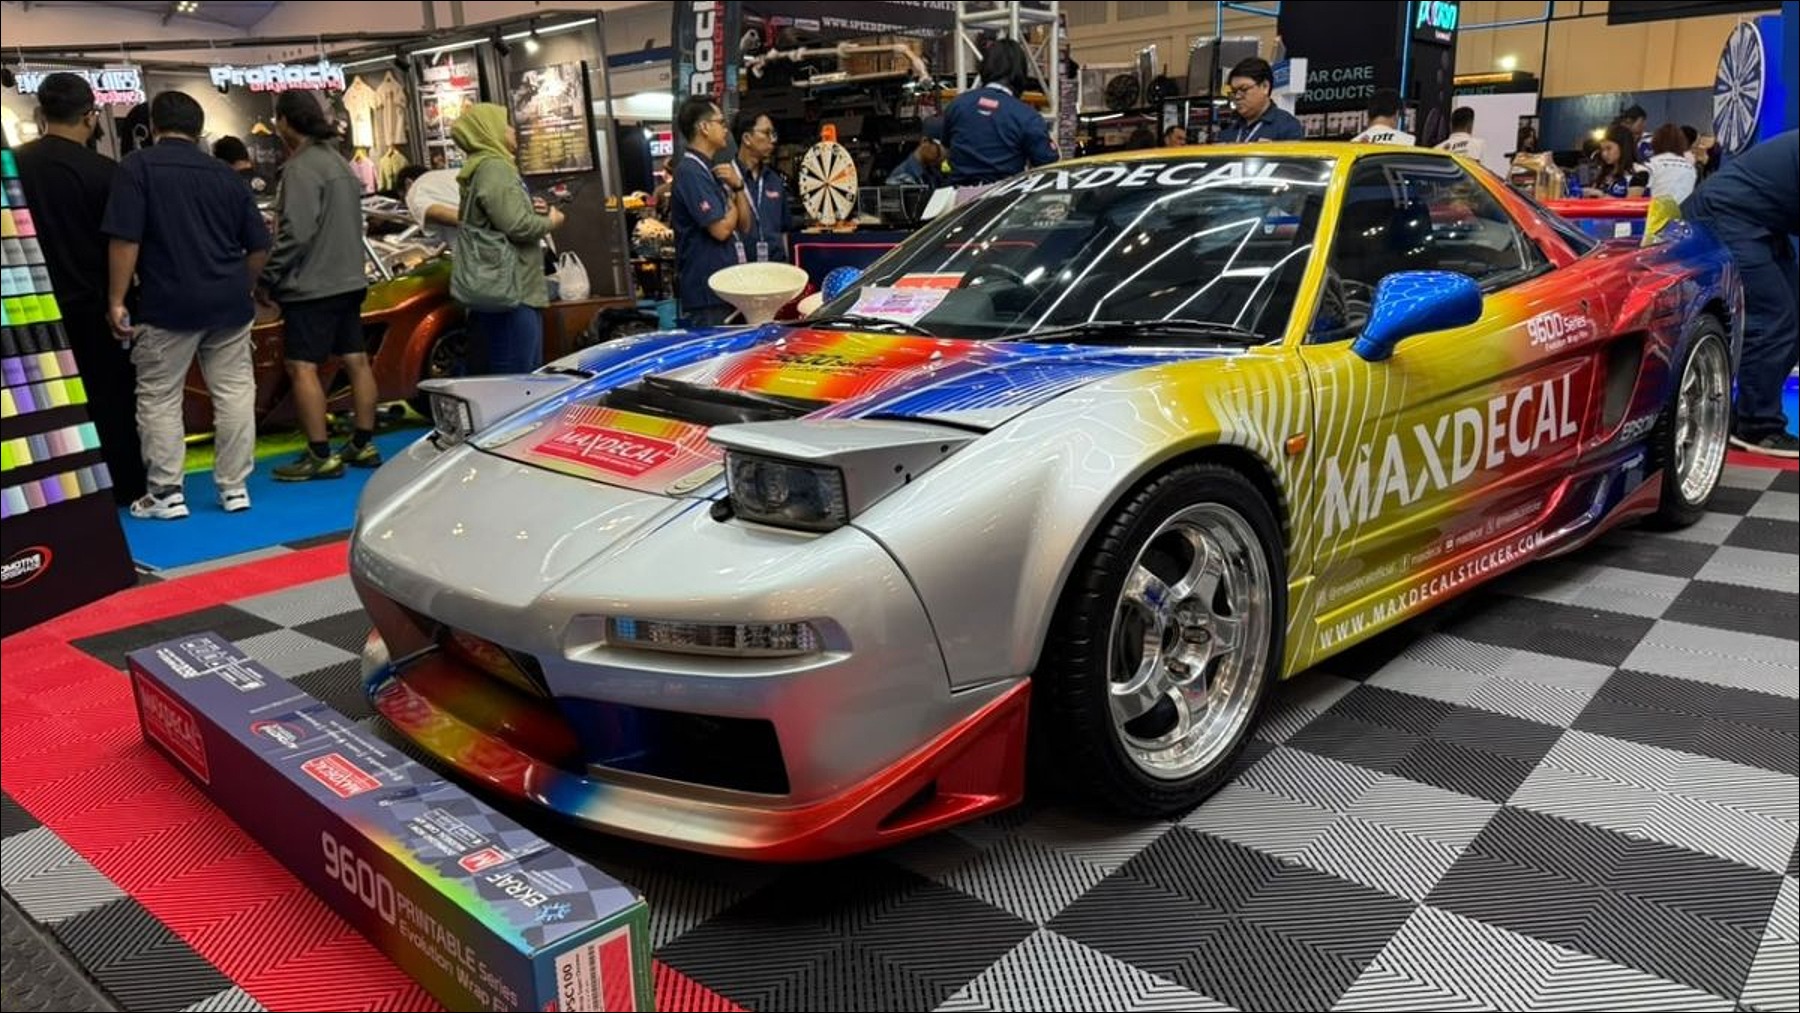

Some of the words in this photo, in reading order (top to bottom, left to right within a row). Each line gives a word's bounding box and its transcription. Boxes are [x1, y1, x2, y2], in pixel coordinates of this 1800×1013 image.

[1304, 69, 1329, 84] AR
[1331, 65, 1374, 82] CARE
[1527, 312, 1564, 347] 9600
[557, 431, 660, 464] MAXDECAL
[1323, 371, 1578, 539] MAXDECAL
[1320, 530, 1545, 650] WWW.MAXDECALSTICKER.COM
[322, 830, 396, 925] 9600
[397, 892, 476, 972] PRINTABLE
[479, 962, 519, 1007] Series
[486, 873, 548, 908] EKRAF
[400, 919, 454, 973] Evolution
[456, 965, 490, 1006] Wrap
